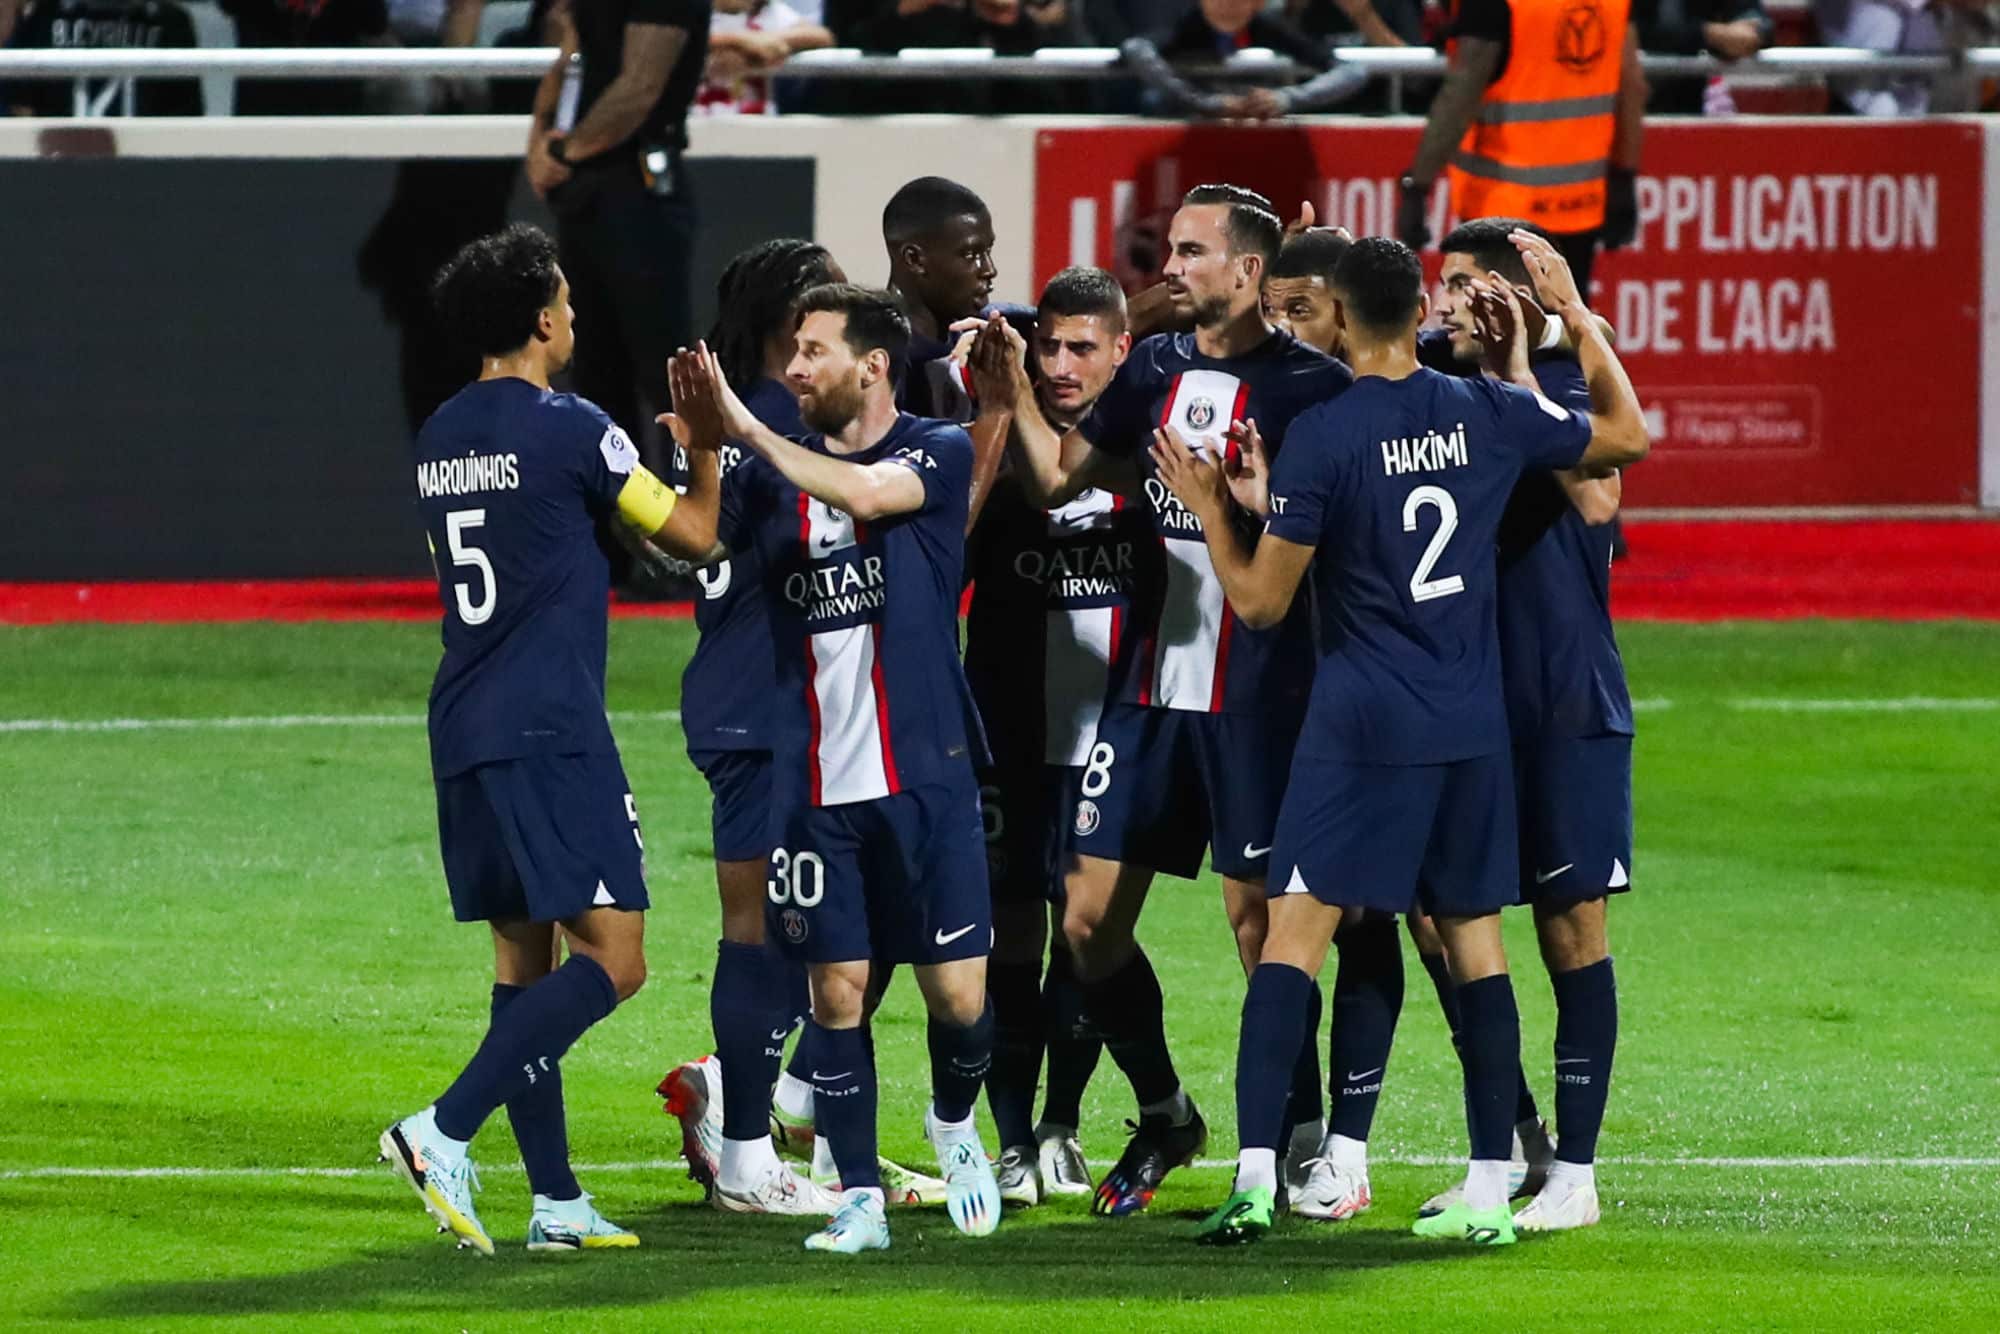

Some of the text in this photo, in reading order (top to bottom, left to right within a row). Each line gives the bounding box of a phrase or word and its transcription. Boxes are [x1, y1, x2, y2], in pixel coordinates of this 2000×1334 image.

[1630, 173, 1939, 251] PPLICATION
[1616, 278, 1837, 352] DE L'ACA
[446, 508, 497, 625] 5
[1014, 541, 1135, 585] QATAR
[1402, 485, 1465, 603] 2
[785, 555, 885, 608] QATAR
[1081, 741, 1116, 798] 8
[767, 847, 825, 908] 30
